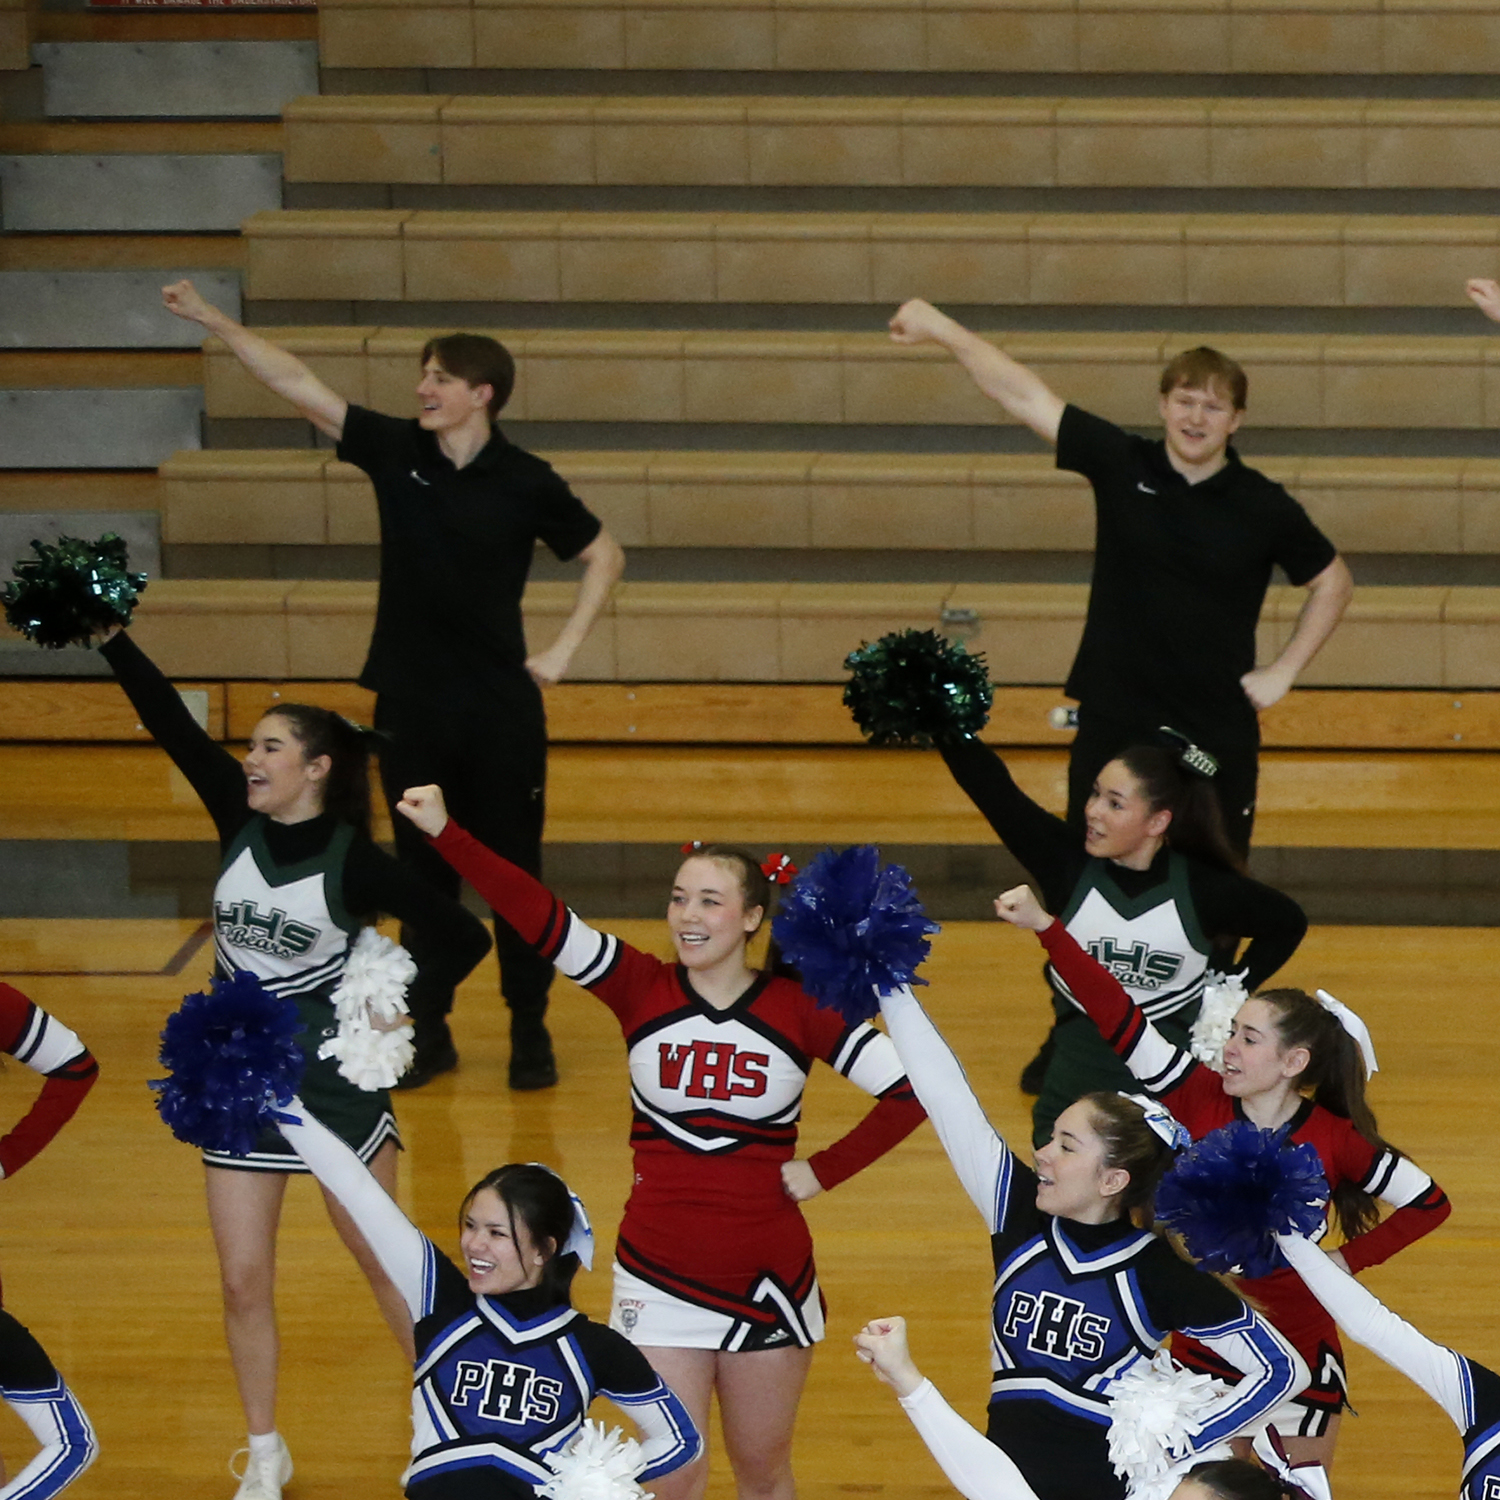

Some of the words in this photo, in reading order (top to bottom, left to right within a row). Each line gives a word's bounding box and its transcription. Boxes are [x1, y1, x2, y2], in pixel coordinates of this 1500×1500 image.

[214, 899, 322, 956] HHS
[227, 923, 294, 960] Bears
[658, 1039, 771, 1101] WHS
[1002, 1289, 1112, 1363] PHS
[450, 1357, 564, 1427] PHS
